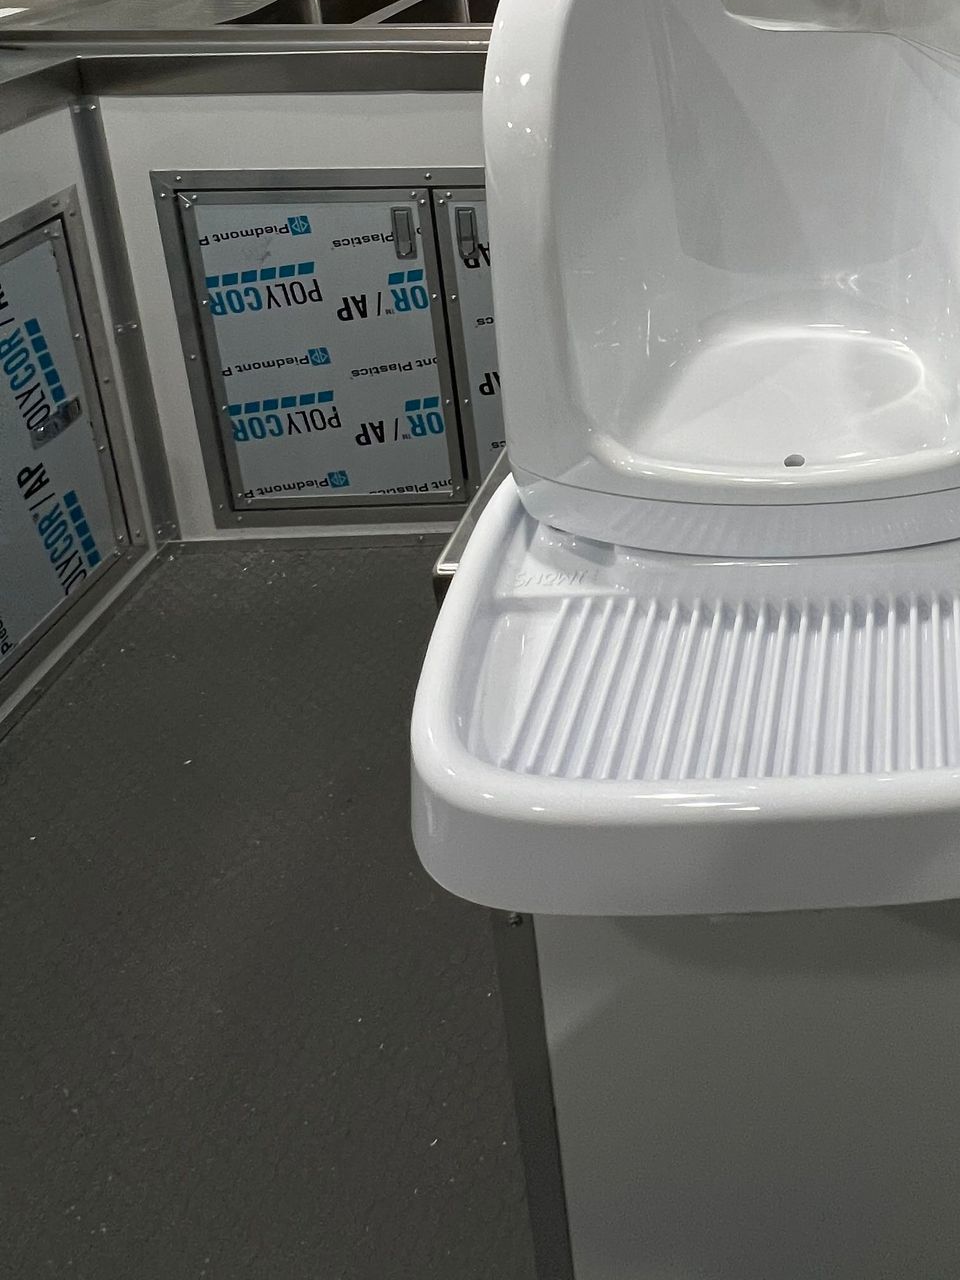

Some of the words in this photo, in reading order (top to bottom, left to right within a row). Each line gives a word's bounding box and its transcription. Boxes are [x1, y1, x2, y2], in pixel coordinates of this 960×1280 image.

[213, 223, 290, 241] Piedmont
[332, 232, 394, 248] Plastics
[336, 294, 368, 321] AP
[237, 353, 309, 374] Piedmont
[351, 361, 413, 377] Plastics
[355, 420, 385, 446] AP
[17, 462, 50, 500] AP
[256, 477, 329, 496] Piedmont
